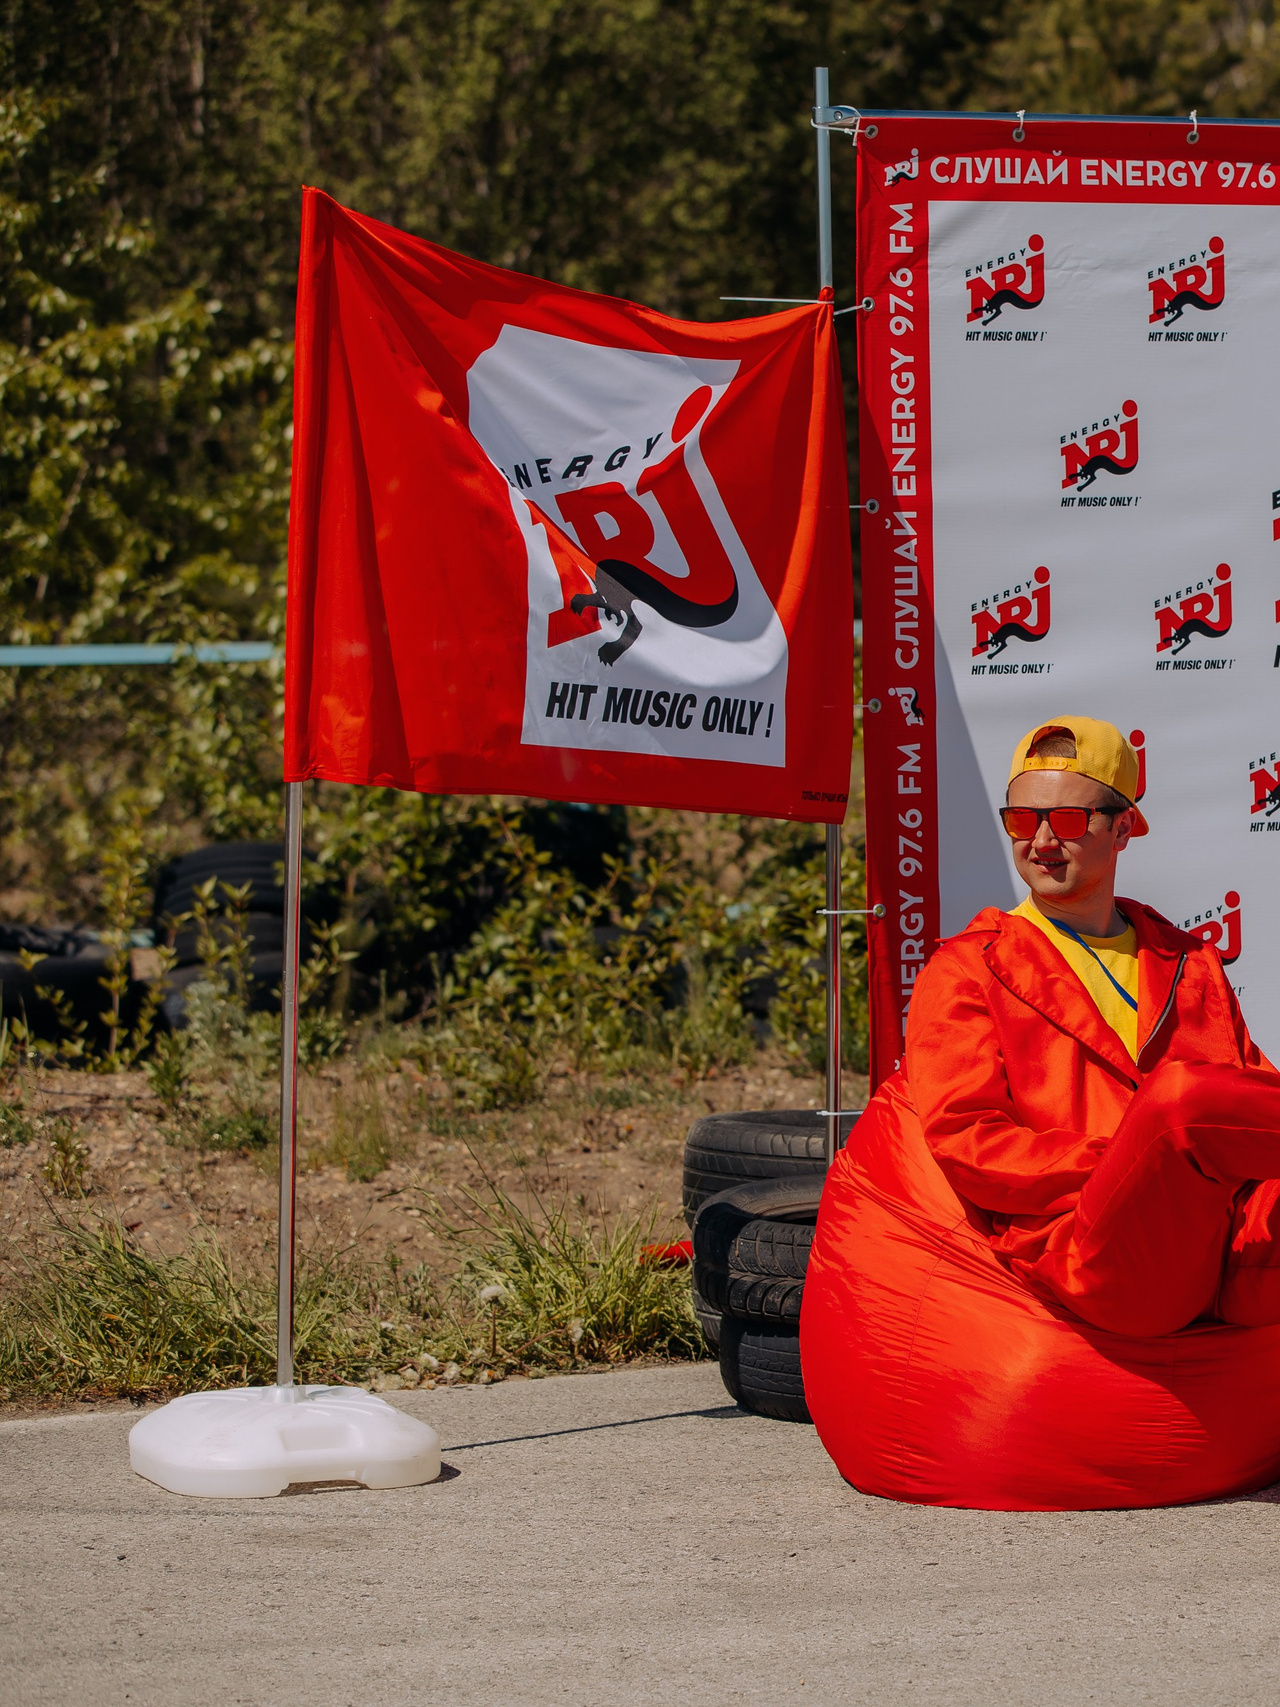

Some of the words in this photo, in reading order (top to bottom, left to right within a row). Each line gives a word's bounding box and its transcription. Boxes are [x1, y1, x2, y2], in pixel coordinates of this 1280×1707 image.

[929, 149, 1069, 185] СЛУШАЙ
[1080, 158, 1208, 188] ENERGY
[1217, 161, 1277, 189] 97.6
[889, 202, 914, 254] FM
[965, 247, 1026, 278] ENERGY
[1147, 249, 1207, 280] ENERGY
[889, 267, 915, 336] 97.6
[965, 331, 982, 342] HIT
[982, 331, 1013, 342] MUSIC
[1014, 331, 1039, 342] ONLY
[1147, 331, 1164, 342] HIT
[1164, 331, 1194, 342] MUSIC
[1196, 331, 1219, 342] ONLY
[889, 347, 917, 496] ENERGY
[1060, 413, 1120, 445] ENERGY
[500, 431, 664, 490] NERGY
[1060, 497, 1077, 508] HIT
[1077, 496, 1108, 507] MUSIC
[1109, 496, 1133, 507] ONLY
[885, 511, 920, 670] СЛУШАЙ
[971, 580, 1032, 612] ENERGY
[1154, 577, 1214, 609] ENERGY
[971, 665, 987, 676] HIT
[988, 664, 1019, 675] MUSIC
[1021, 663, 1045, 674] ONLY
[1155, 660, 1171, 671] HIT
[1172, 659, 1202, 671] MUSIC
[1204, 659, 1227, 670] ONLY
[545, 681, 599, 721] HIT
[601, 686, 698, 730] MUSIC
[702, 695, 765, 737] ONLY
[896, 743, 922, 794] FM
[898, 808, 923, 877] 97.6
[1249, 822, 1266, 833] HIT
